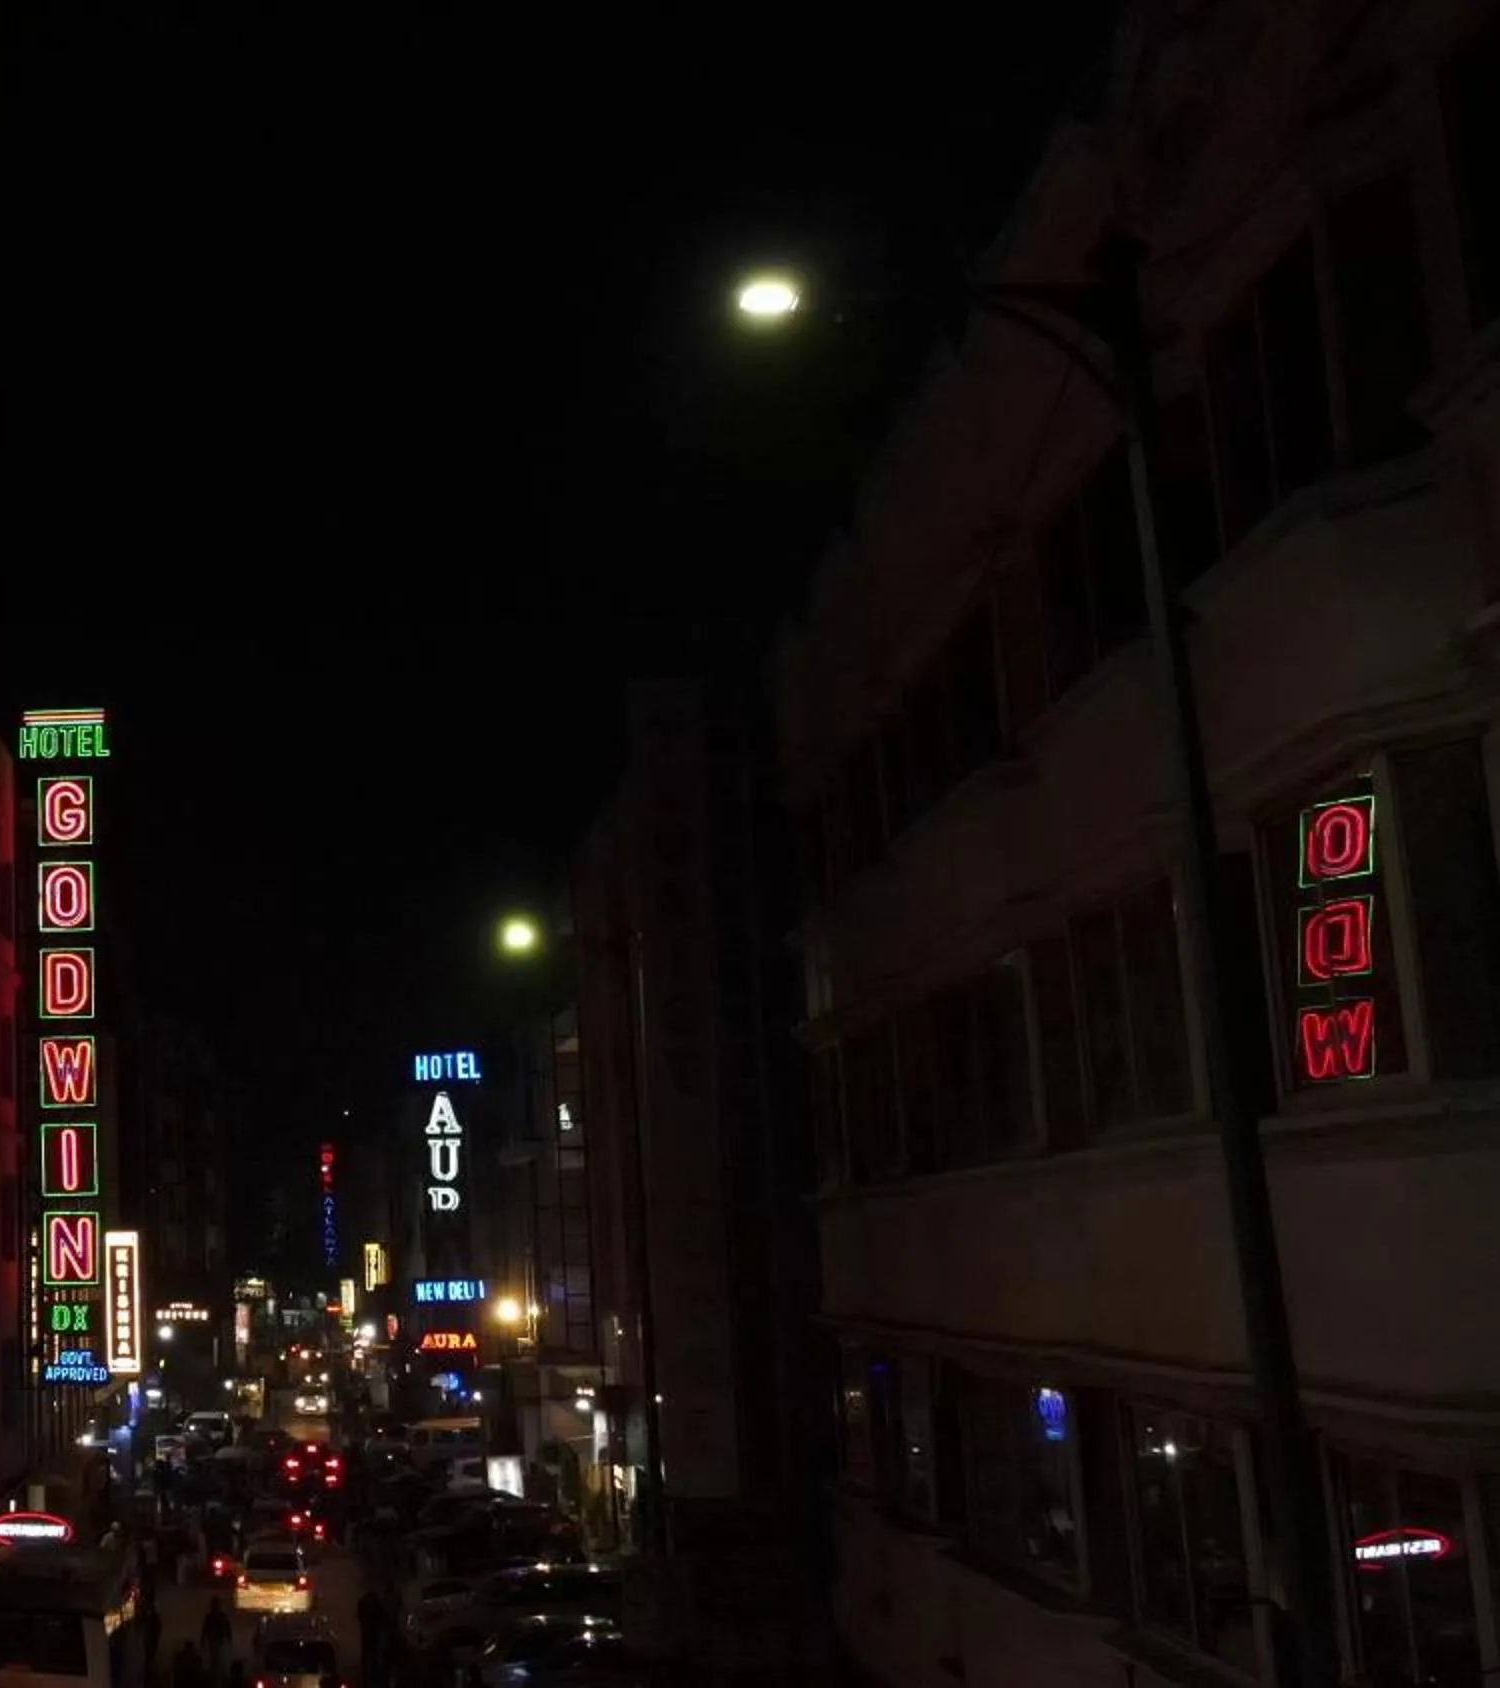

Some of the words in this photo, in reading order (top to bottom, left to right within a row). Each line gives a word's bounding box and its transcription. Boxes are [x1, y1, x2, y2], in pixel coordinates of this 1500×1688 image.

[19, 725, 111, 759] HOTEL
[43, 781, 93, 1280] GODWIN
[415, 1052, 481, 1081] HOTEL
[415, 1281, 445, 1302] NEW
[51, 1303, 90, 1332] DX
[421, 1333, 477, 1349] AURA
[45, 1365, 108, 1382] APPROVED
